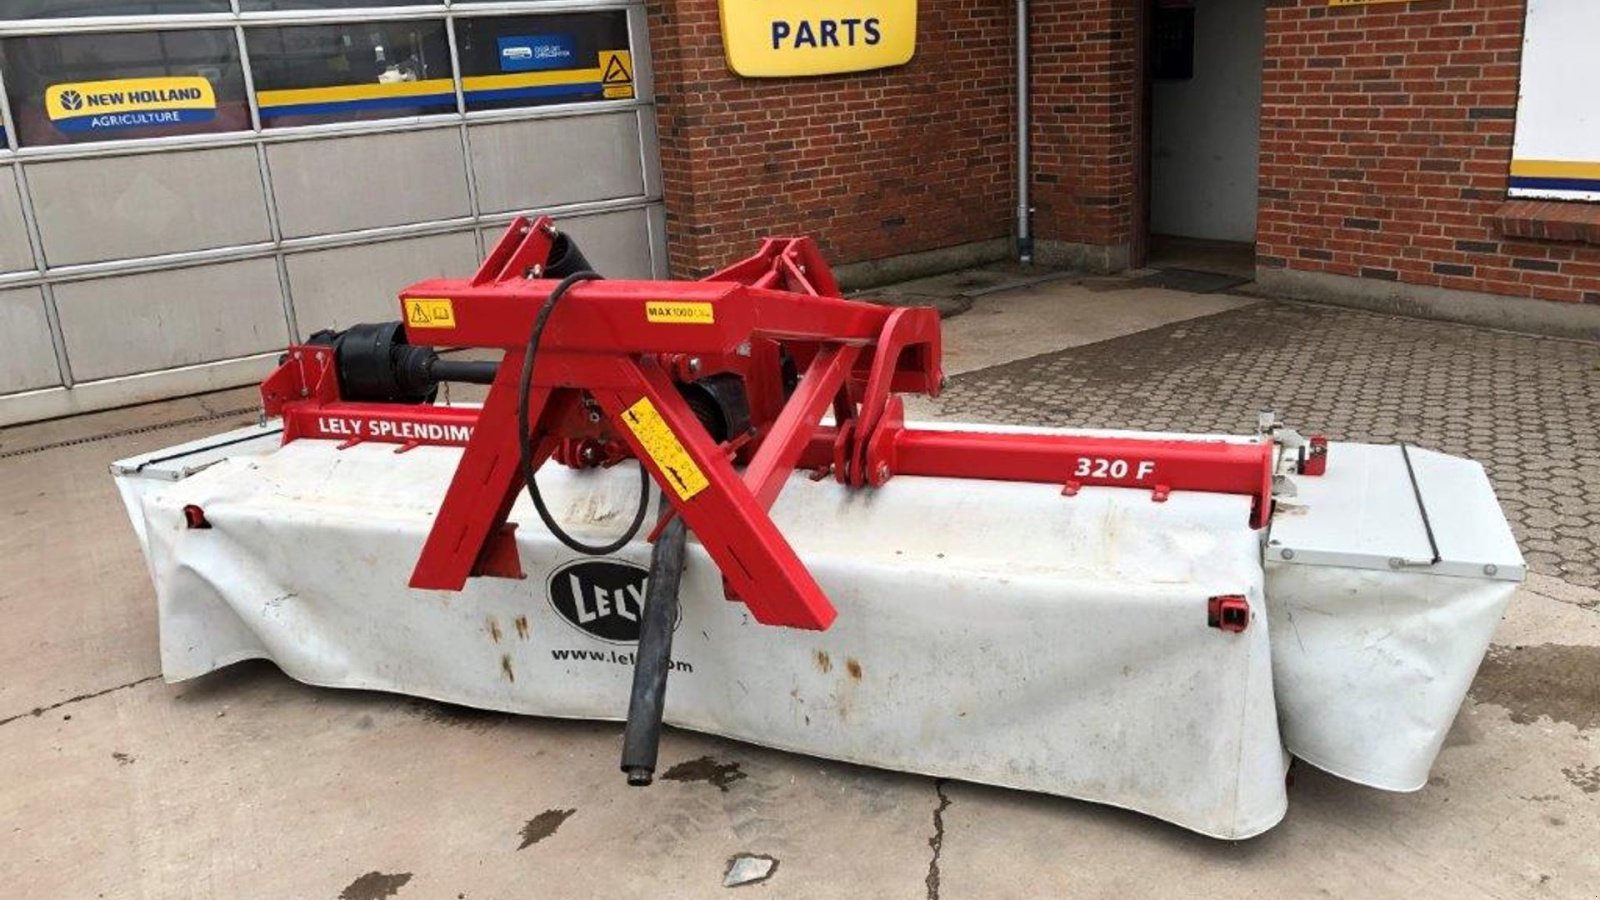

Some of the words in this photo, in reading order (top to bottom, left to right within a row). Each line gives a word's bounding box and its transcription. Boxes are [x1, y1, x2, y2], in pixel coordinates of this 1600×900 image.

[771, 18, 881, 49] PARTS
[87, 93, 124, 106] NEW
[127, 87, 202, 104] HOLLAND
[91, 111, 181, 128] AGRICULTURE
[648, 307, 672, 317] MAX
[318, 417, 362, 435] LELY
[368, 420, 475, 442] SPLENDIM
[1074, 457, 1129, 479] 320
[1135, 461, 1156, 480] F
[568, 572, 650, 625] LELY
[551, 649, 694, 673] www.lelom
